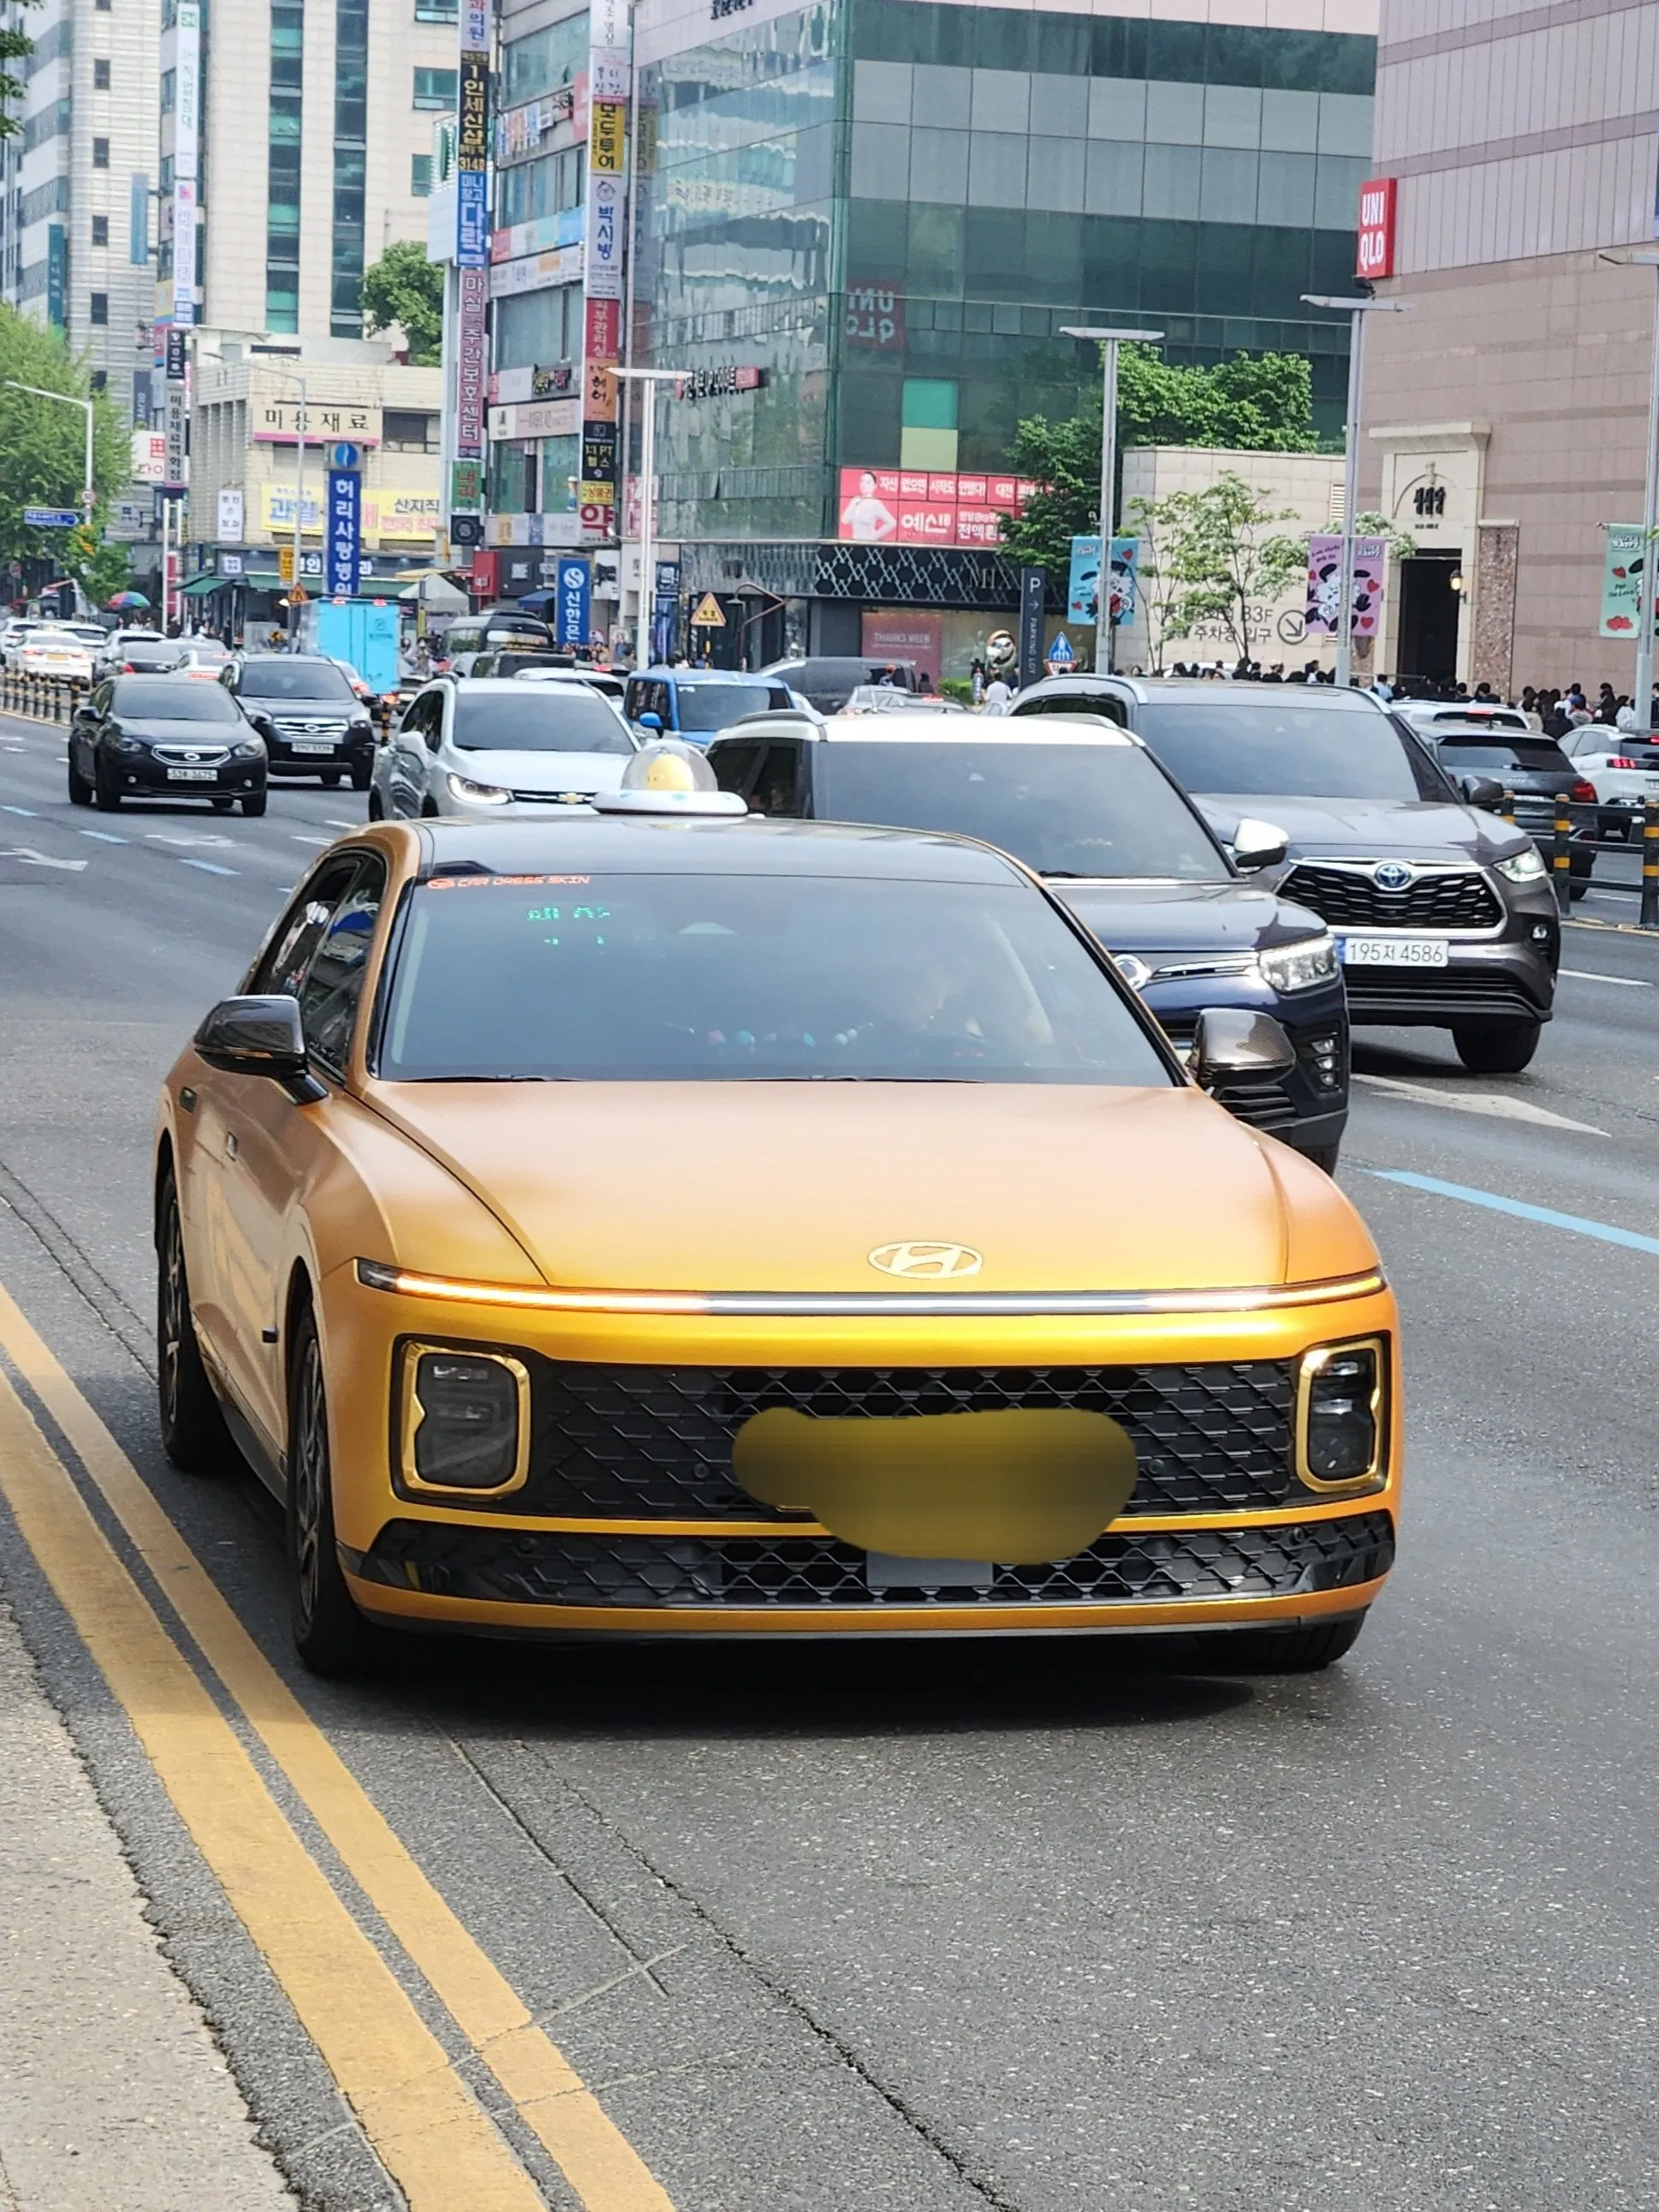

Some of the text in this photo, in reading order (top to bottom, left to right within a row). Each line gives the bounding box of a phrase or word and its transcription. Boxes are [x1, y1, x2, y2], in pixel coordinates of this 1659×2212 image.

[1361, 191, 1385, 227] UNI
[1359, 230, 1385, 271] QLO
[265, 409, 369, 432] 미용재료
[334, 479, 354, 595] 허리사랑병원
[1030, 577, 1040, 592] P
[565, 591, 580, 640] 신한은
[1029, 617, 1038, 655] PARKING
[457, 876, 590, 887] CAR DRESS SKIN
[1400, 944, 1443, 962] 4586
